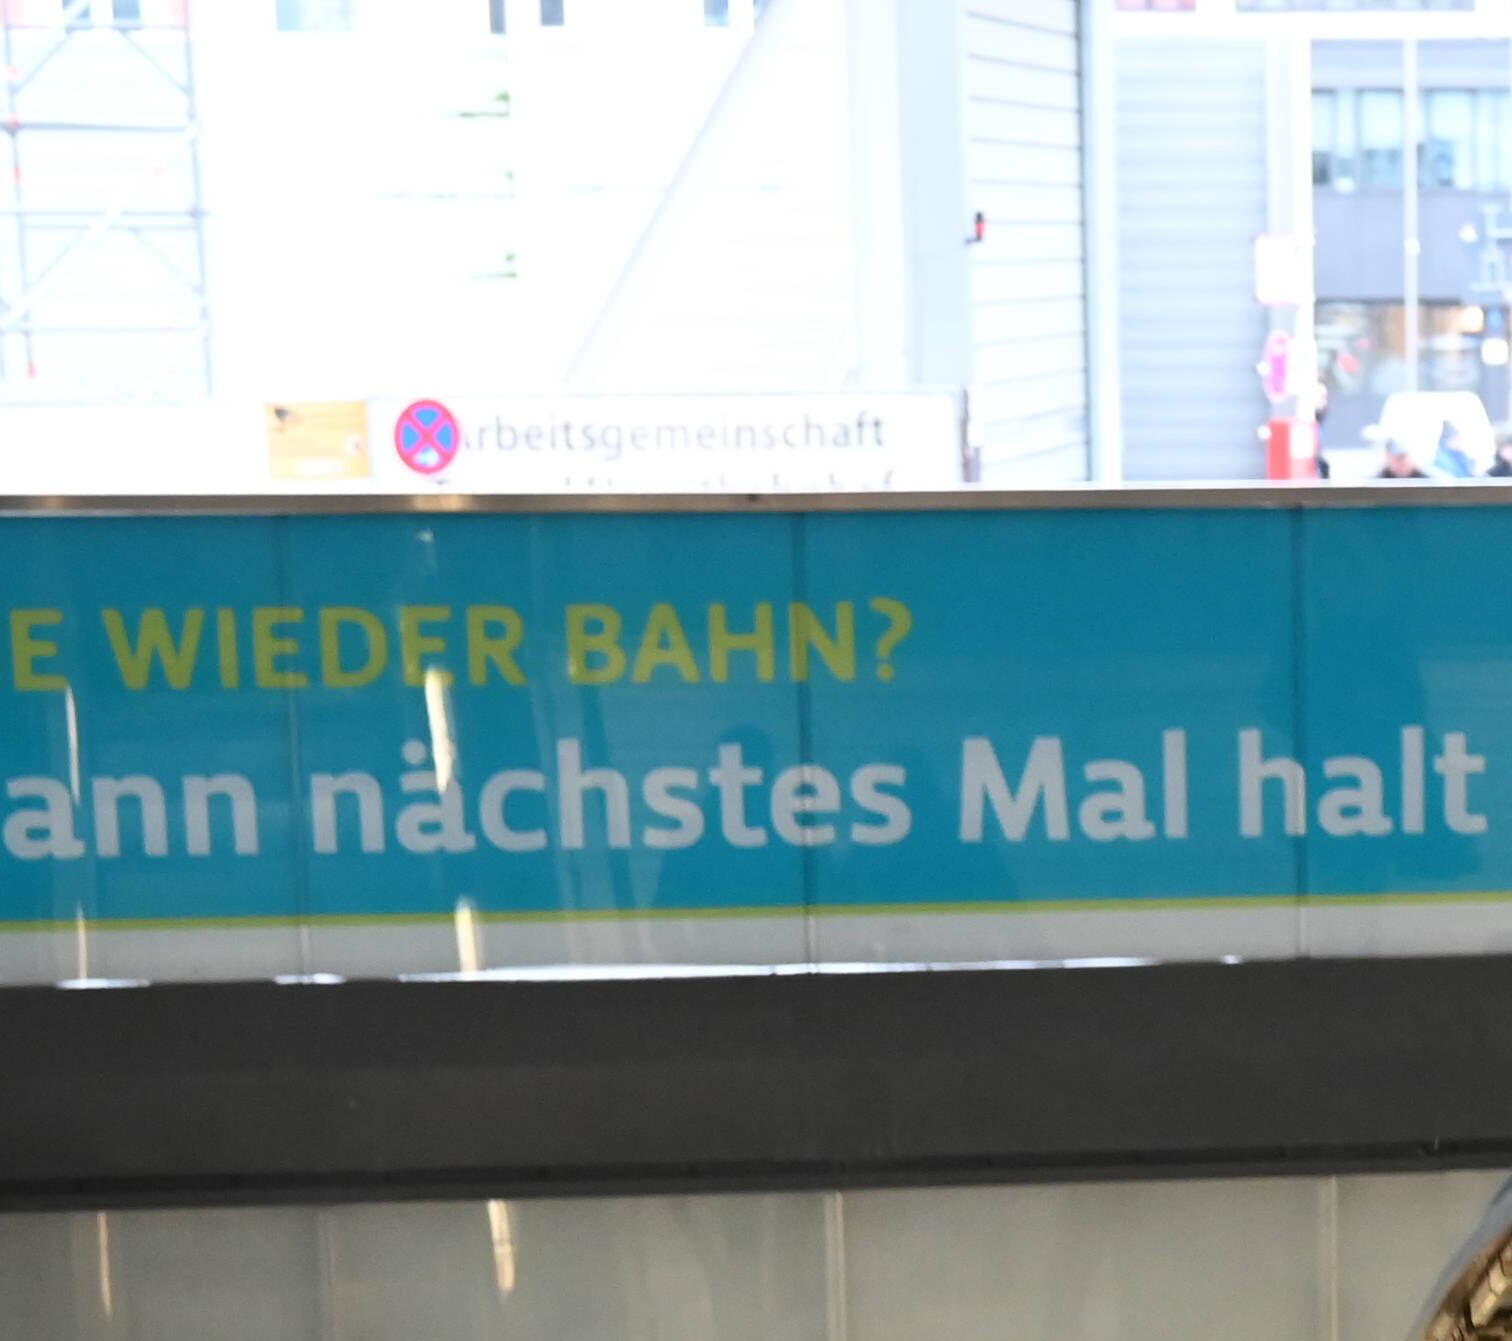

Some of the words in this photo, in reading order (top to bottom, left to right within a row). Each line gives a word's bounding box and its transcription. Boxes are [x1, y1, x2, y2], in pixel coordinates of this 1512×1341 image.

[462, 408, 887, 460] rbeitsgemeinschaft
[100, 605, 528, 691] WIEDER
[564, 597, 912, 684] BAHN?
[309, 737, 912, 855] nächstes
[957, 729, 1187, 843] Mal
[1236, 726, 1487, 838] halt
